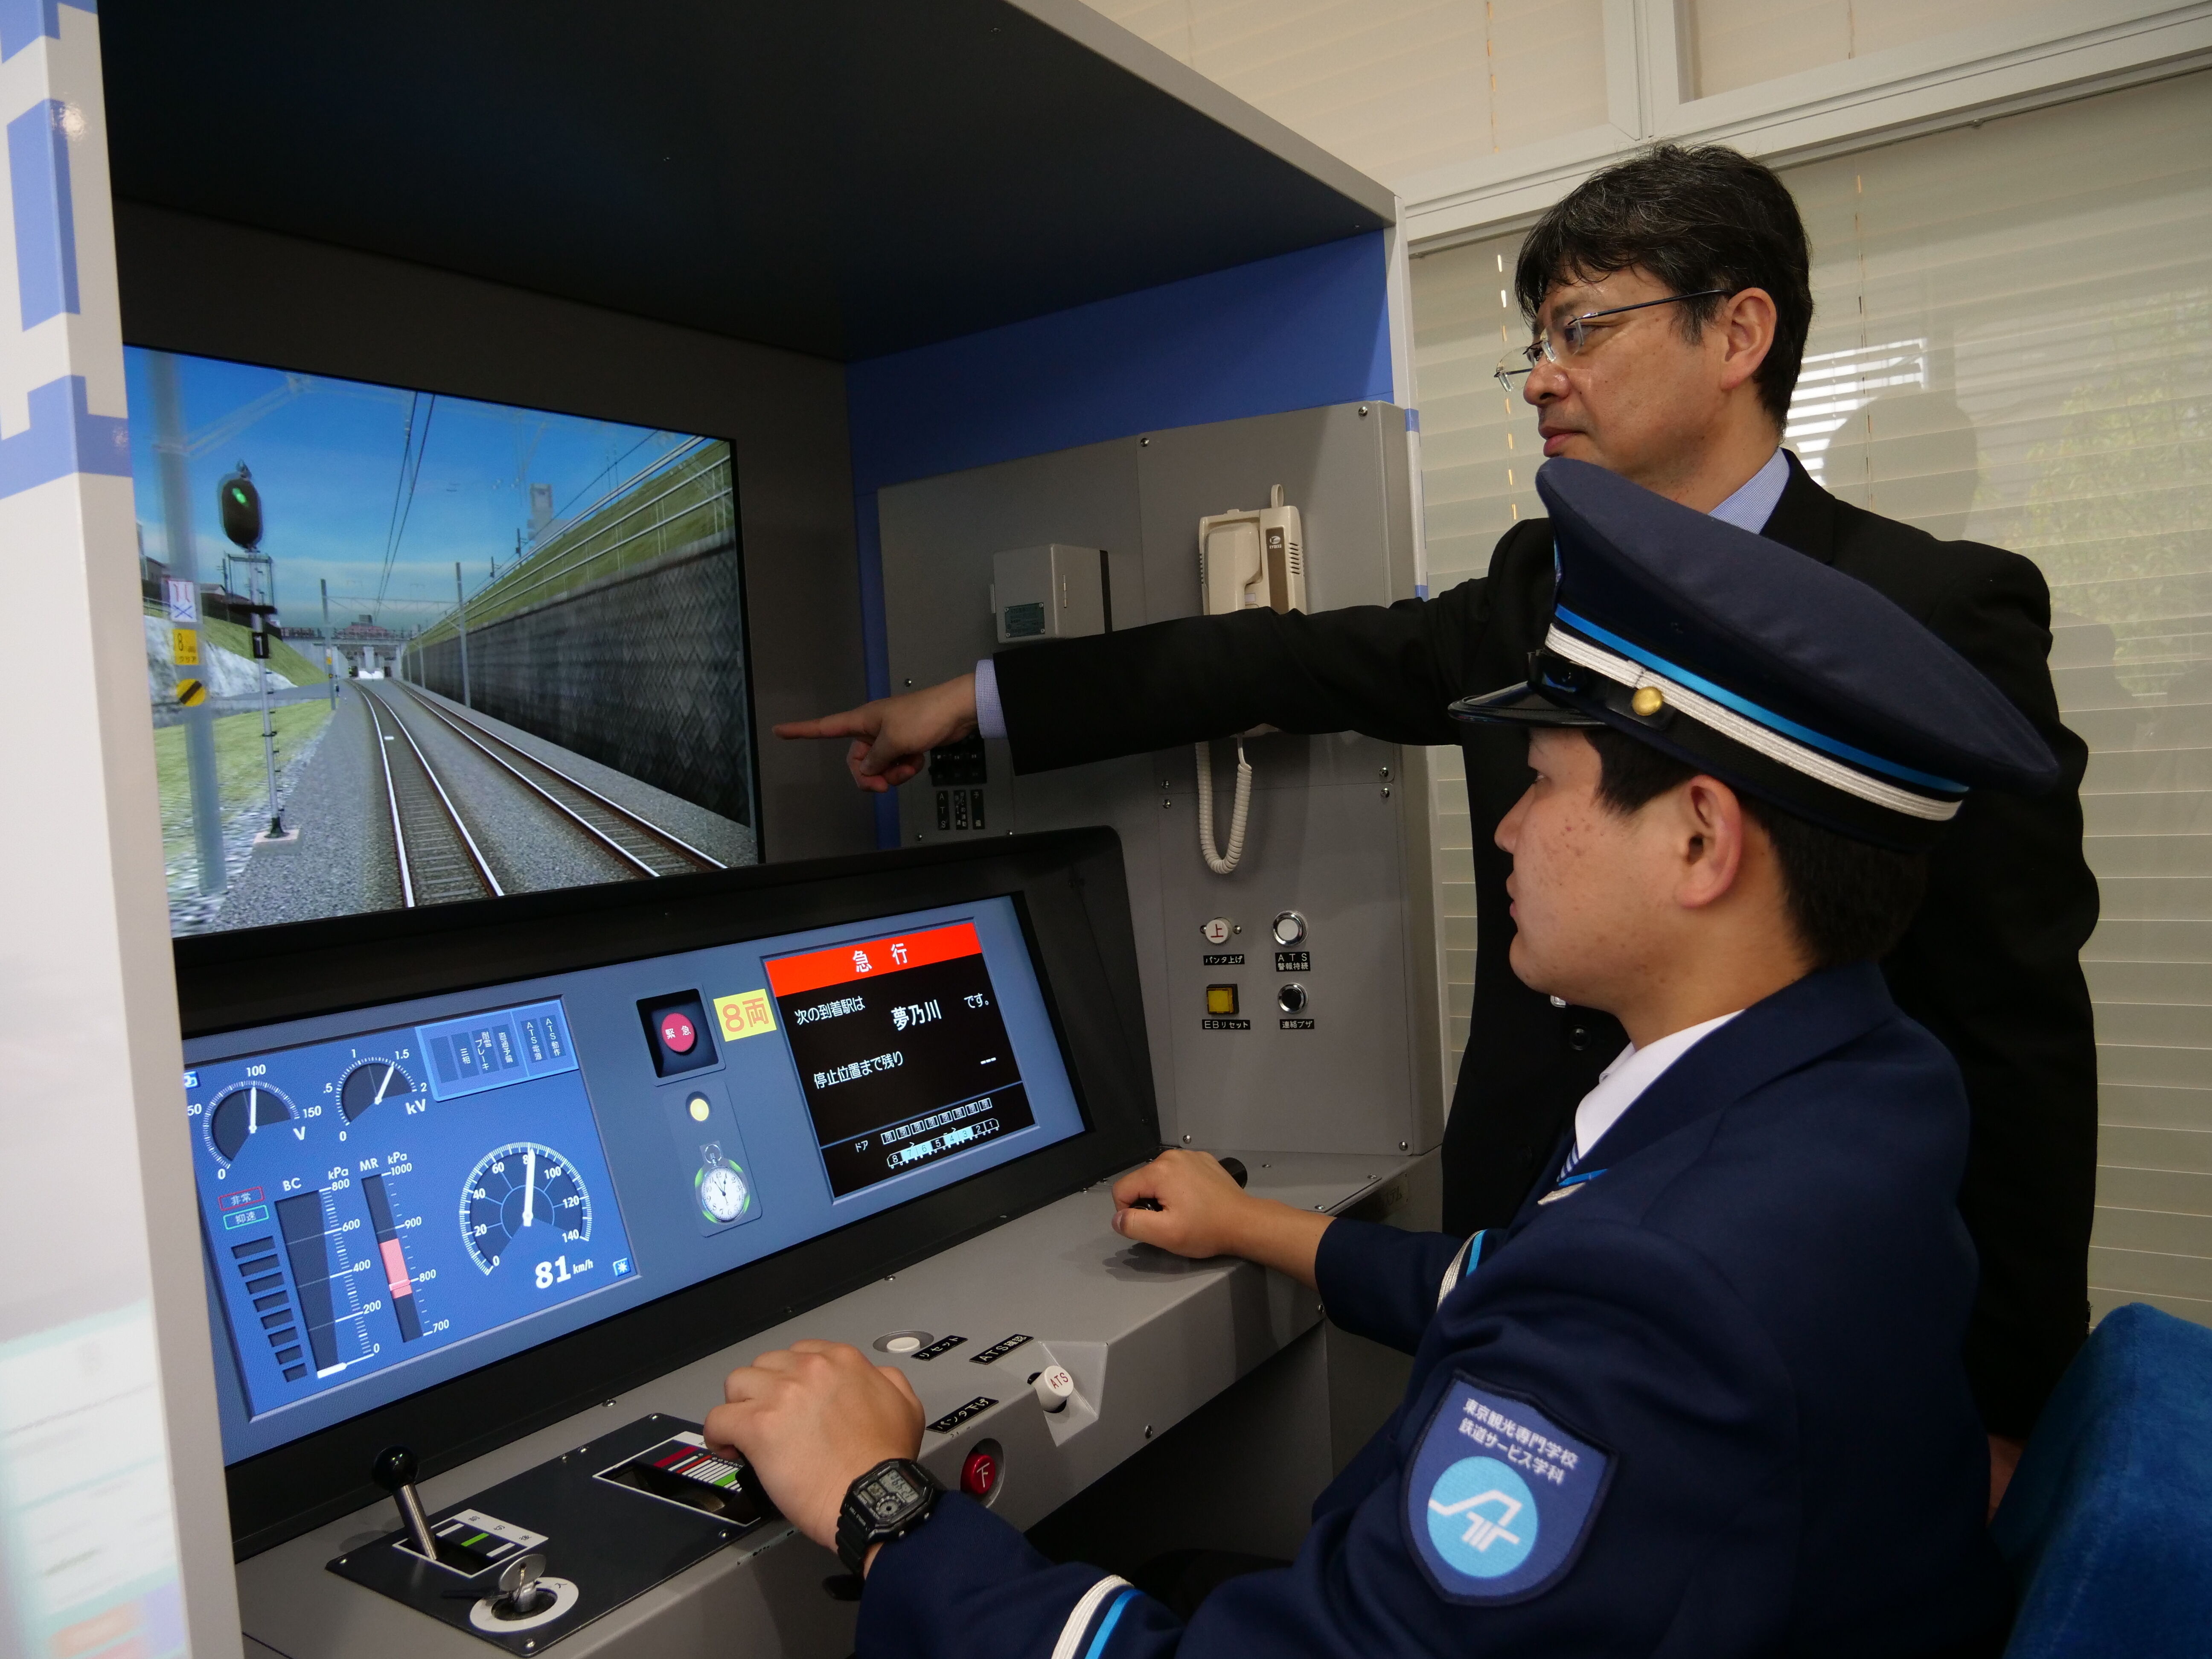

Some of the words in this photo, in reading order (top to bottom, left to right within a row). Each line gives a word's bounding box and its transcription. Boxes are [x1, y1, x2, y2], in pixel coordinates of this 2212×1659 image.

[1211, 924, 1224, 938] 上
[853, 943, 908, 973] 急行
[1278, 953, 1307, 961] ATS
[1278, 962, 1308, 970] 警報持続
[722, 997, 769, 1032] 8両
[795, 995, 865, 1025] 次の到着駅は
[891, 999, 942, 1031] 夢乃川
[963, 993, 990, 1009] です。
[665, 1025, 691, 1039] 緊急
[395, 1049, 409, 1059] 1.5
[246, 1065, 266, 1077] 100
[814, 1051, 903, 1089] 停止位置まで残り
[421, 1083, 427, 1092] 2
[303, 1106, 322, 1118] 150
[405, 1099, 426, 1115] kV
[293, 1127, 306, 1141] V
[340, 1132, 346, 1141] 0
[855, 1140, 869, 1152] ドア
[360, 1158, 378, 1172] MR
[388, 1152, 407, 1165] kPa
[892, 1155, 899, 1163] 8
[218, 1169, 226, 1179] 0
[328, 1167, 349, 1180] kPa
[391, 1163, 412, 1176] 1000
[492, 1162, 504, 1174] 60
[544, 1166, 562, 1179] 100
[283, 1178, 302, 1191] BC
[331, 1179, 350, 1191] 800
[472, 1188, 486, 1199] 40
[563, 1195, 579, 1208] 120
[342, 1219, 360, 1231] 600
[405, 1217, 422, 1229] 900
[474, 1224, 487, 1236] 20
[562, 1229, 579, 1243] 140
[353, 1260, 371, 1272] 400
[493, 1256, 500, 1266] 0
[419, 1269, 436, 1282] 800
[535, 1255, 571, 1289] 81
[573, 1260, 594, 1274] km/h
[363, 1300, 381, 1313] 200
[433, 1320, 449, 1333] 700
[373, 1344, 380, 1353] 0
[920, 1336, 958, 1357] リセット
[1049, 1372, 1068, 1389] ATS
[937, 1398, 989, 1429] パンタ下げ
[1463, 1398, 1579, 1470] 東京観光専門学校
[1458, 1418, 1565, 1485] 鉄道サービス学科
[977, 1462, 990, 1488] 下
